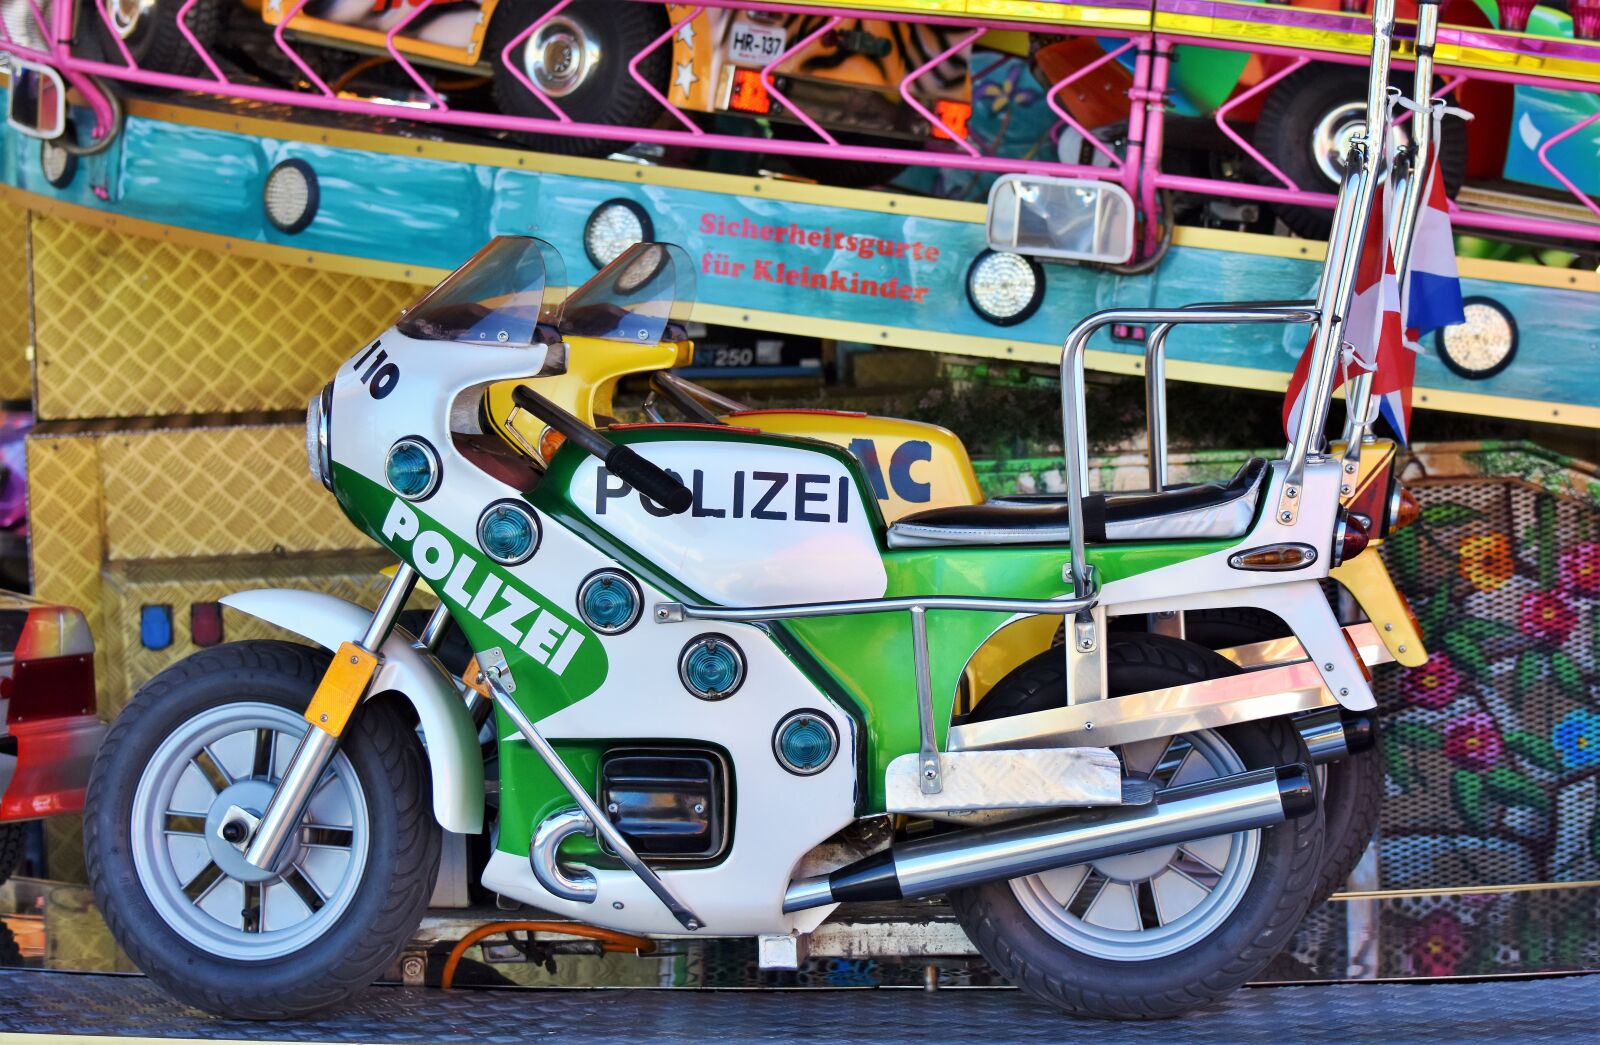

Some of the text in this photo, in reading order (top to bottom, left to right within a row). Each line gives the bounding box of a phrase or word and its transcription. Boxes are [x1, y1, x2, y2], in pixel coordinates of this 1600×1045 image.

[733, 32, 781, 56] HR-137
[700, 213, 940, 262] Sicherheitsgurte
[701, 252, 929, 302] für Kleinkinder
[353, 340, 400, 400] 110
[715, 348, 753, 366] 250
[381, 497, 586, 677] POLIZEI
